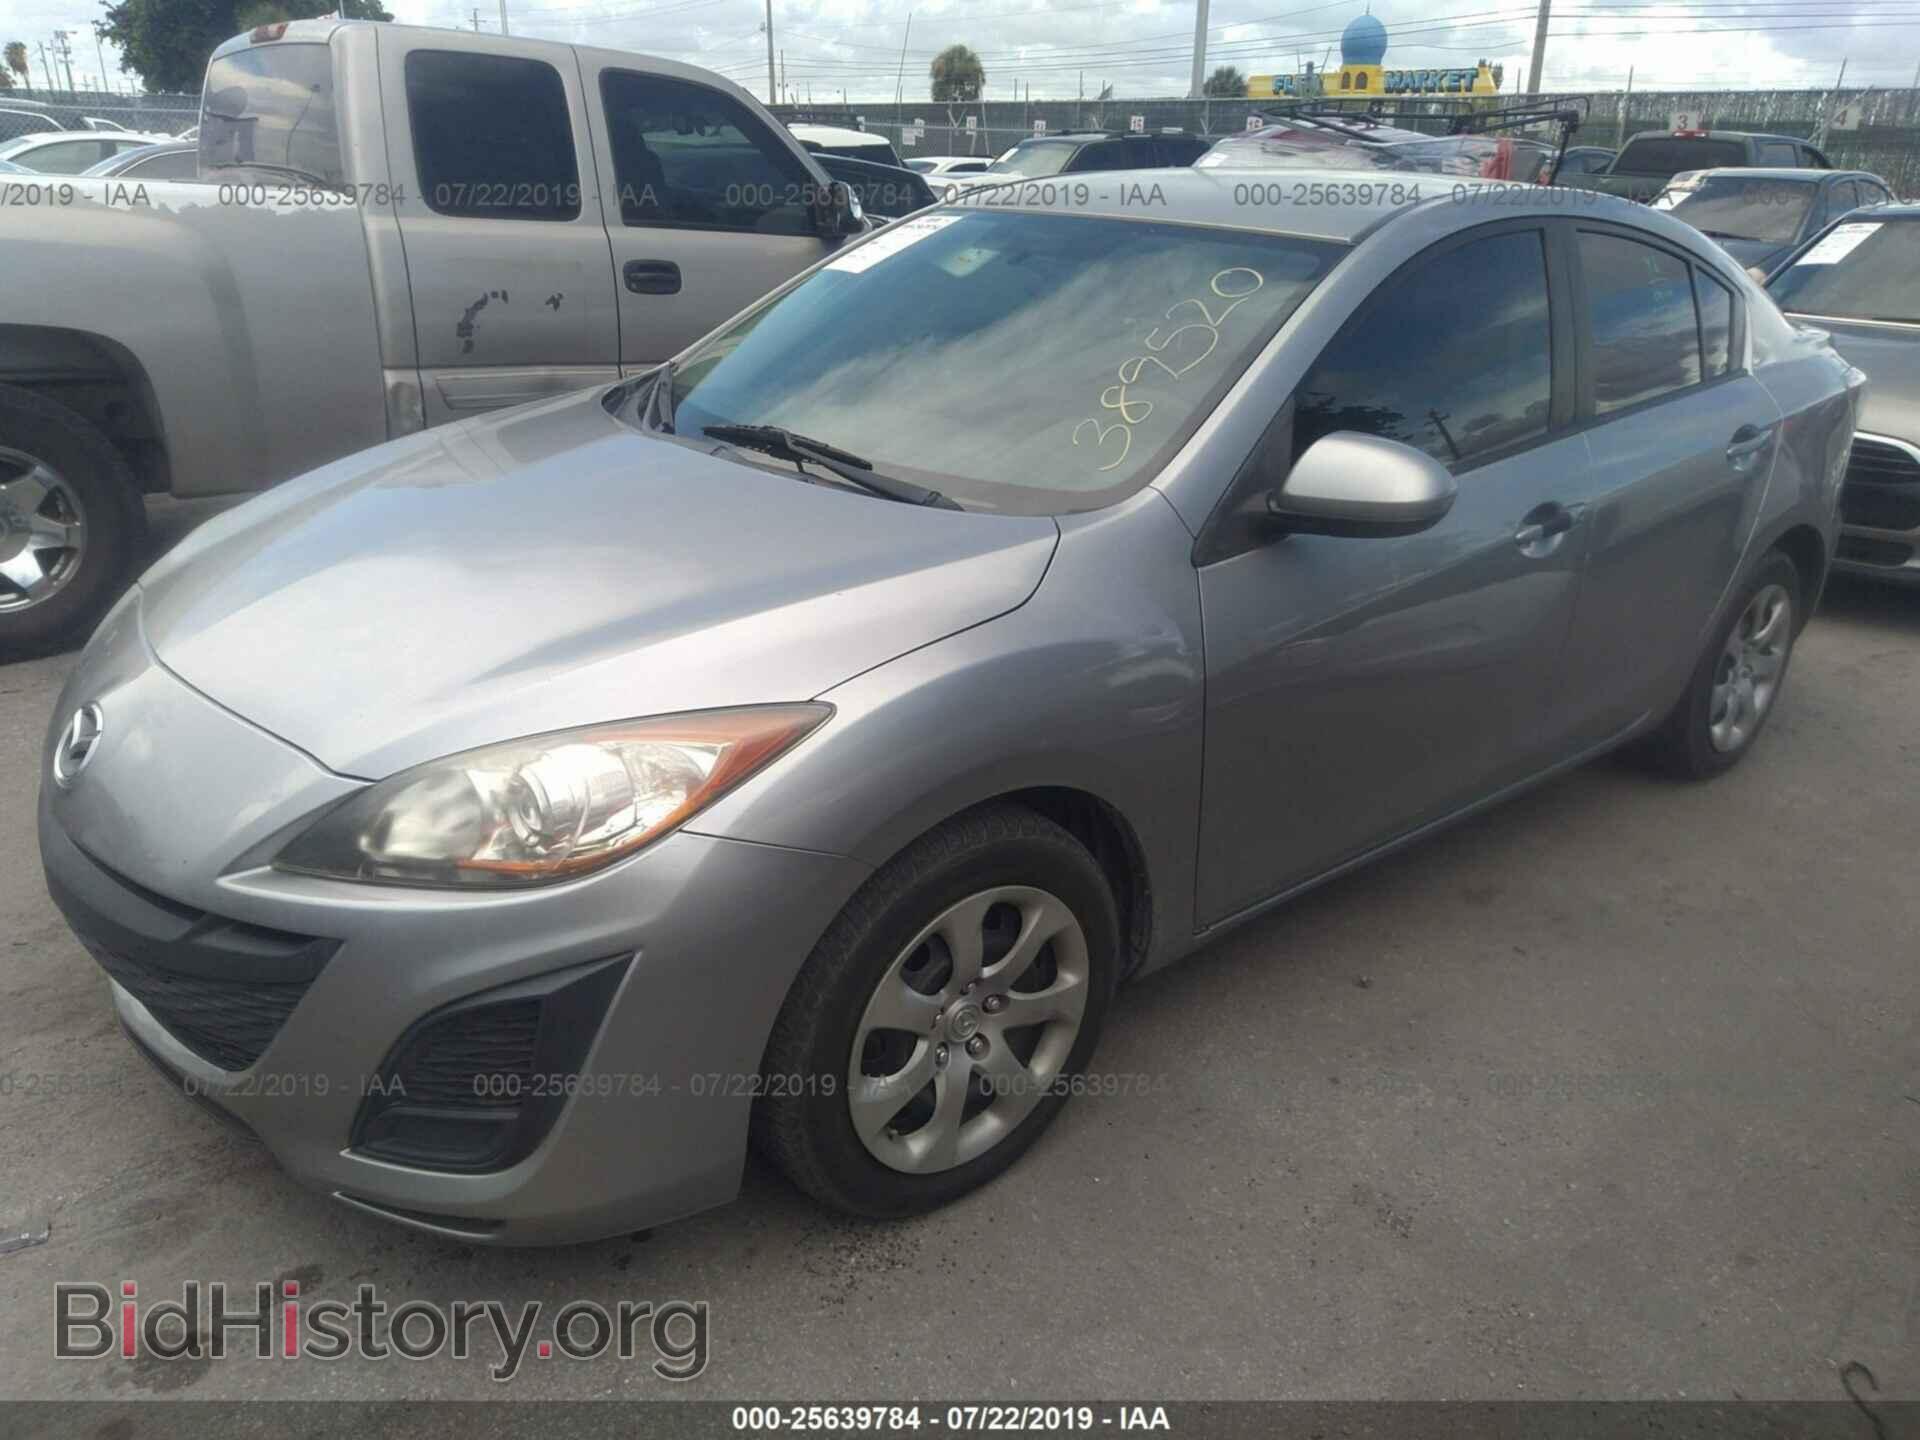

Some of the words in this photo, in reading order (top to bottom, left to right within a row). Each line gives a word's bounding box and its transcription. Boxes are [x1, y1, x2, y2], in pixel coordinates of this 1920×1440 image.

[1384, 69, 1479, 94] MARKET
[1677, 114, 1689, 130] 3
[1073, 267, 1264, 471] 389520
